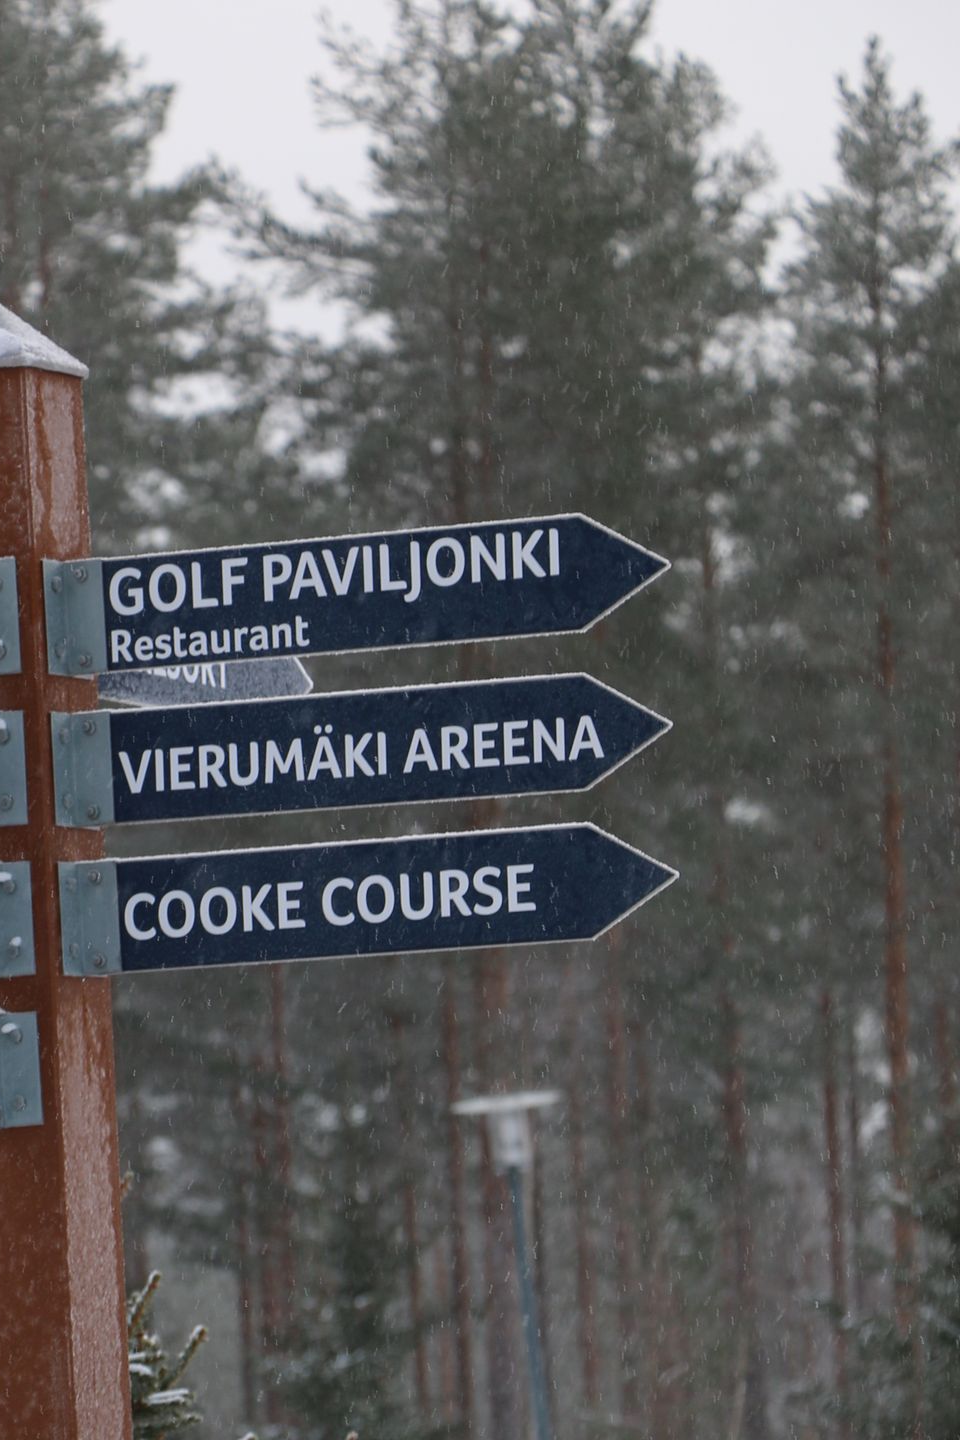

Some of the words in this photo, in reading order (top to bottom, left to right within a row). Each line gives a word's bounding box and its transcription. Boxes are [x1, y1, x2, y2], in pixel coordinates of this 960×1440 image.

[108, 557, 248, 616] GOLF
[263, 528, 561, 603] PAVILJONKI
[110, 615, 310, 663] Restaurant
[118, 725, 388, 795] VIERUMÄKI
[403, 715, 605, 774] AREENA
[124, 881, 306, 942] COOKE
[322, 864, 537, 920] COURSE
